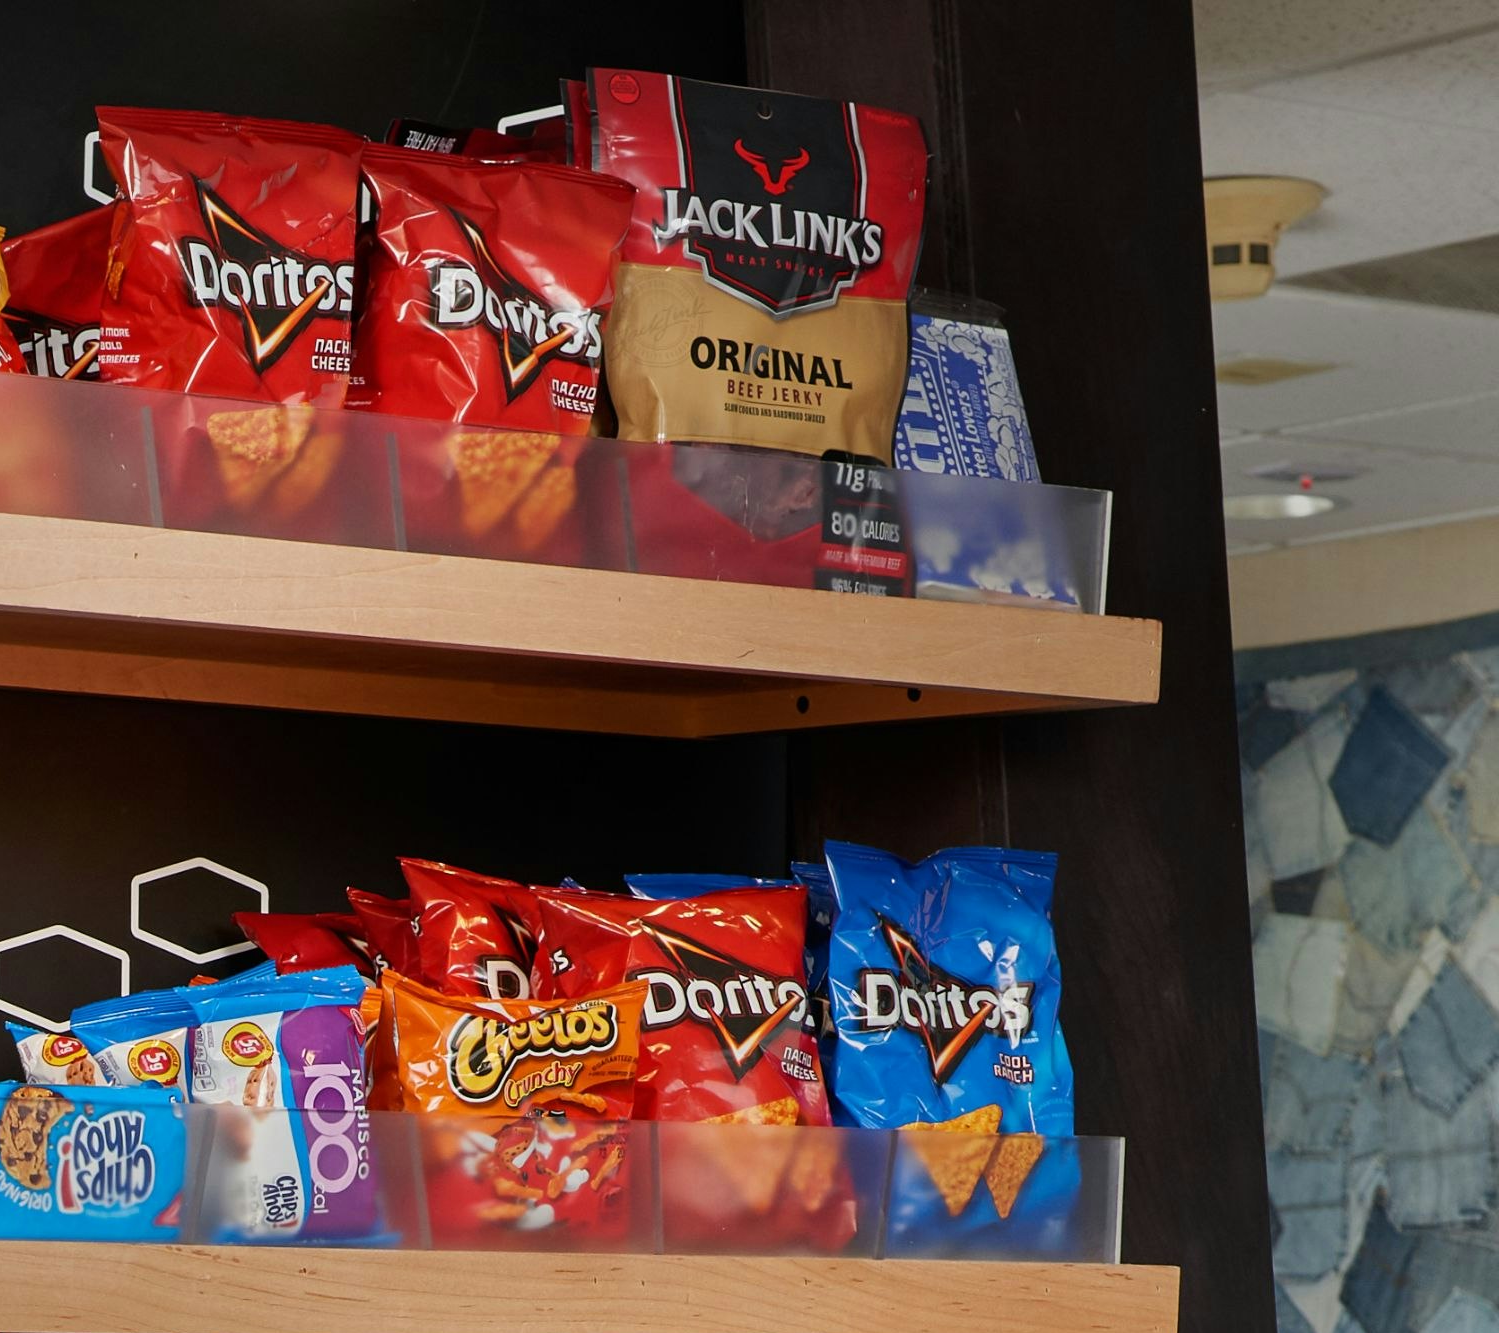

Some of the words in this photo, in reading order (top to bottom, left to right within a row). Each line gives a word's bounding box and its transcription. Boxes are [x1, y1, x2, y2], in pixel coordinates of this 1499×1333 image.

[659, 188, 763, 246] JACK
[772, 202, 883, 265] LINK'S
[188, 240, 353, 312] Doritos
[106, 328, 130, 337] MORE
[437, 265, 602, 358] Doritos
[690, 336, 853, 390] ORIGINAL
[551, 379, 597, 398] NACHO
[551, 394, 597, 414] CHEESE
[727, 379, 764, 400] BEEF
[772, 387, 823, 407] JERKY
[957, 390, 981, 444] Lovers
[832, 512, 857, 537] 80
[863, 520, 899, 542] CALORIES
[866, 973, 1031, 1031] Doritos
[452, 1005, 615, 1096] Cheetos
[781, 1060, 818, 1082] CHEESE
[784, 1046, 813, 1067] NACHO
[993, 1063, 1034, 1084] RANCH
[999, 1052, 1031, 1069] COOL
[505, 1062, 582, 1107] Crunchy
[303, 1058, 359, 1194] 100
[350, 1069, 371, 1181] NABISCO
[77, 1143, 153, 1203] Chips
